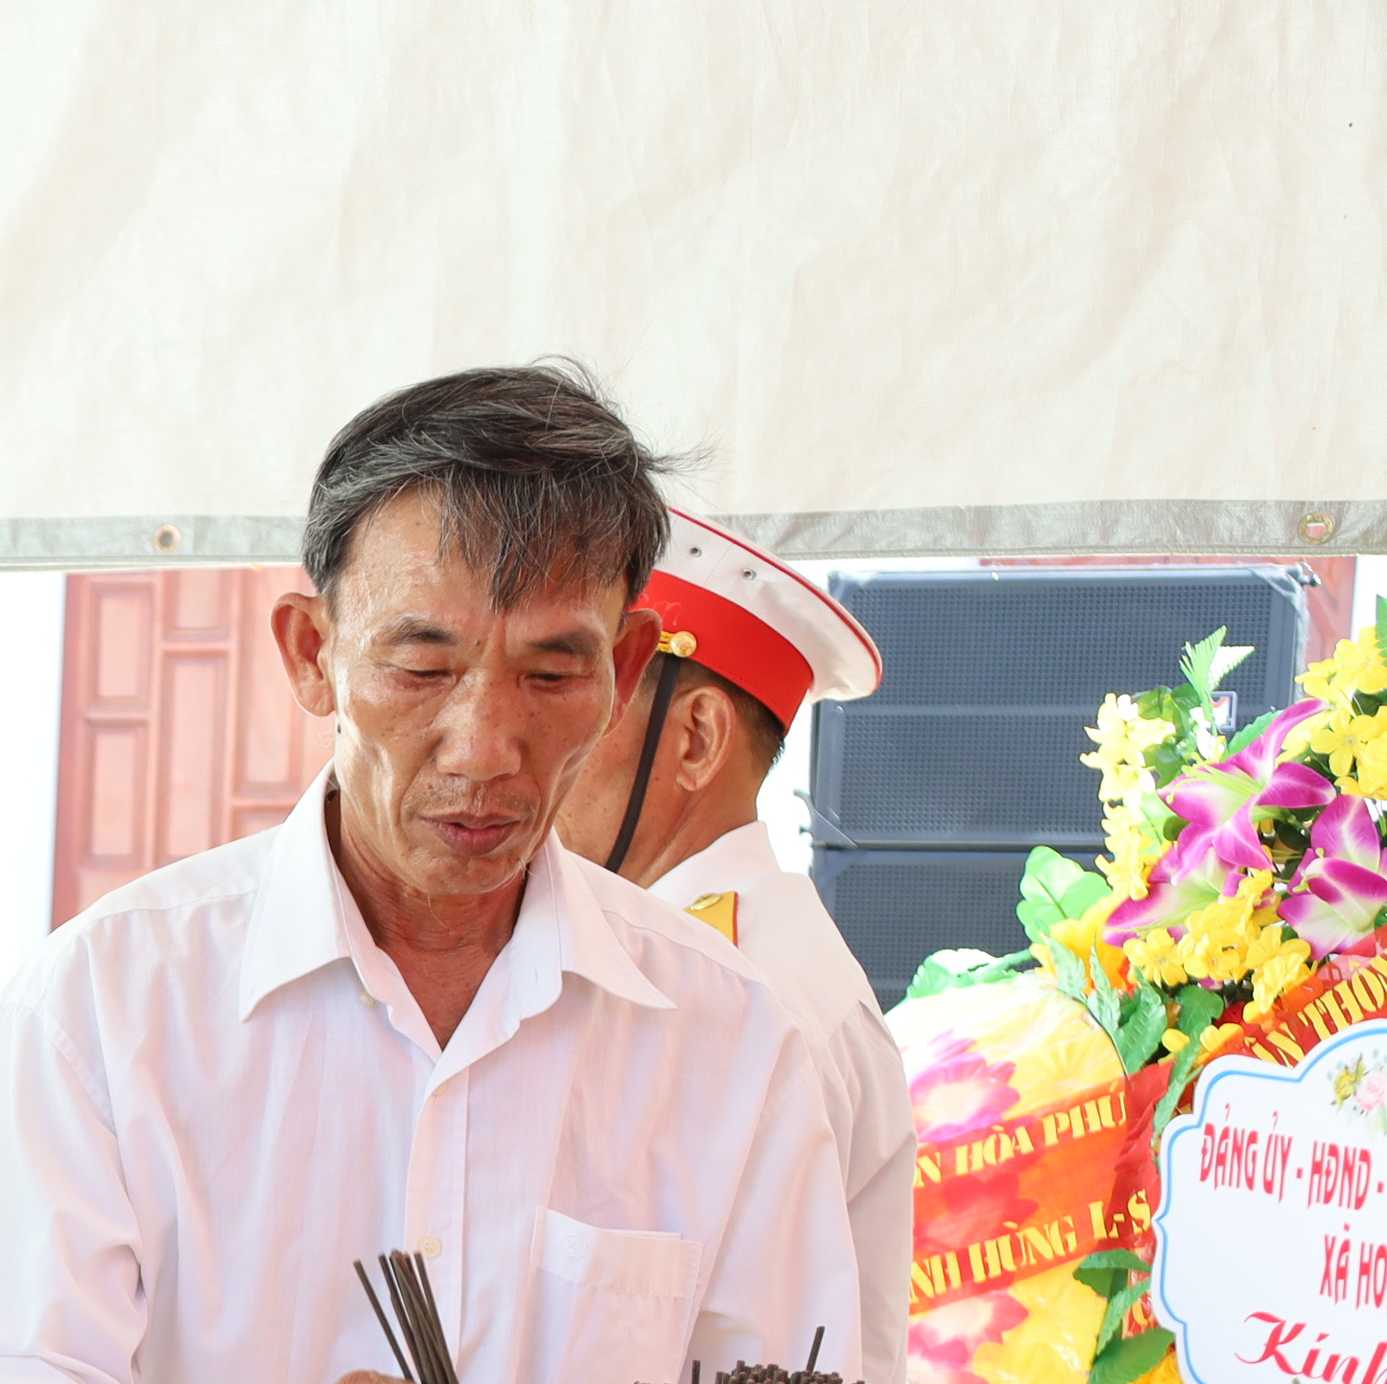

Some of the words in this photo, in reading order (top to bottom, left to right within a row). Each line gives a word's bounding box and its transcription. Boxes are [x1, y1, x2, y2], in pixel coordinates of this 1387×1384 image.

[955, 1124, 1035, 1176] HÒA
[1042, 1080, 1127, 1147] PHÚ
[1200, 1103, 1259, 1192] ĐẢNG
[1263, 1110, 1294, 1204] ỦY
[1307, 1139, 1373, 1212] HĐND
[968, 1220, 1078, 1284] HÙNG
